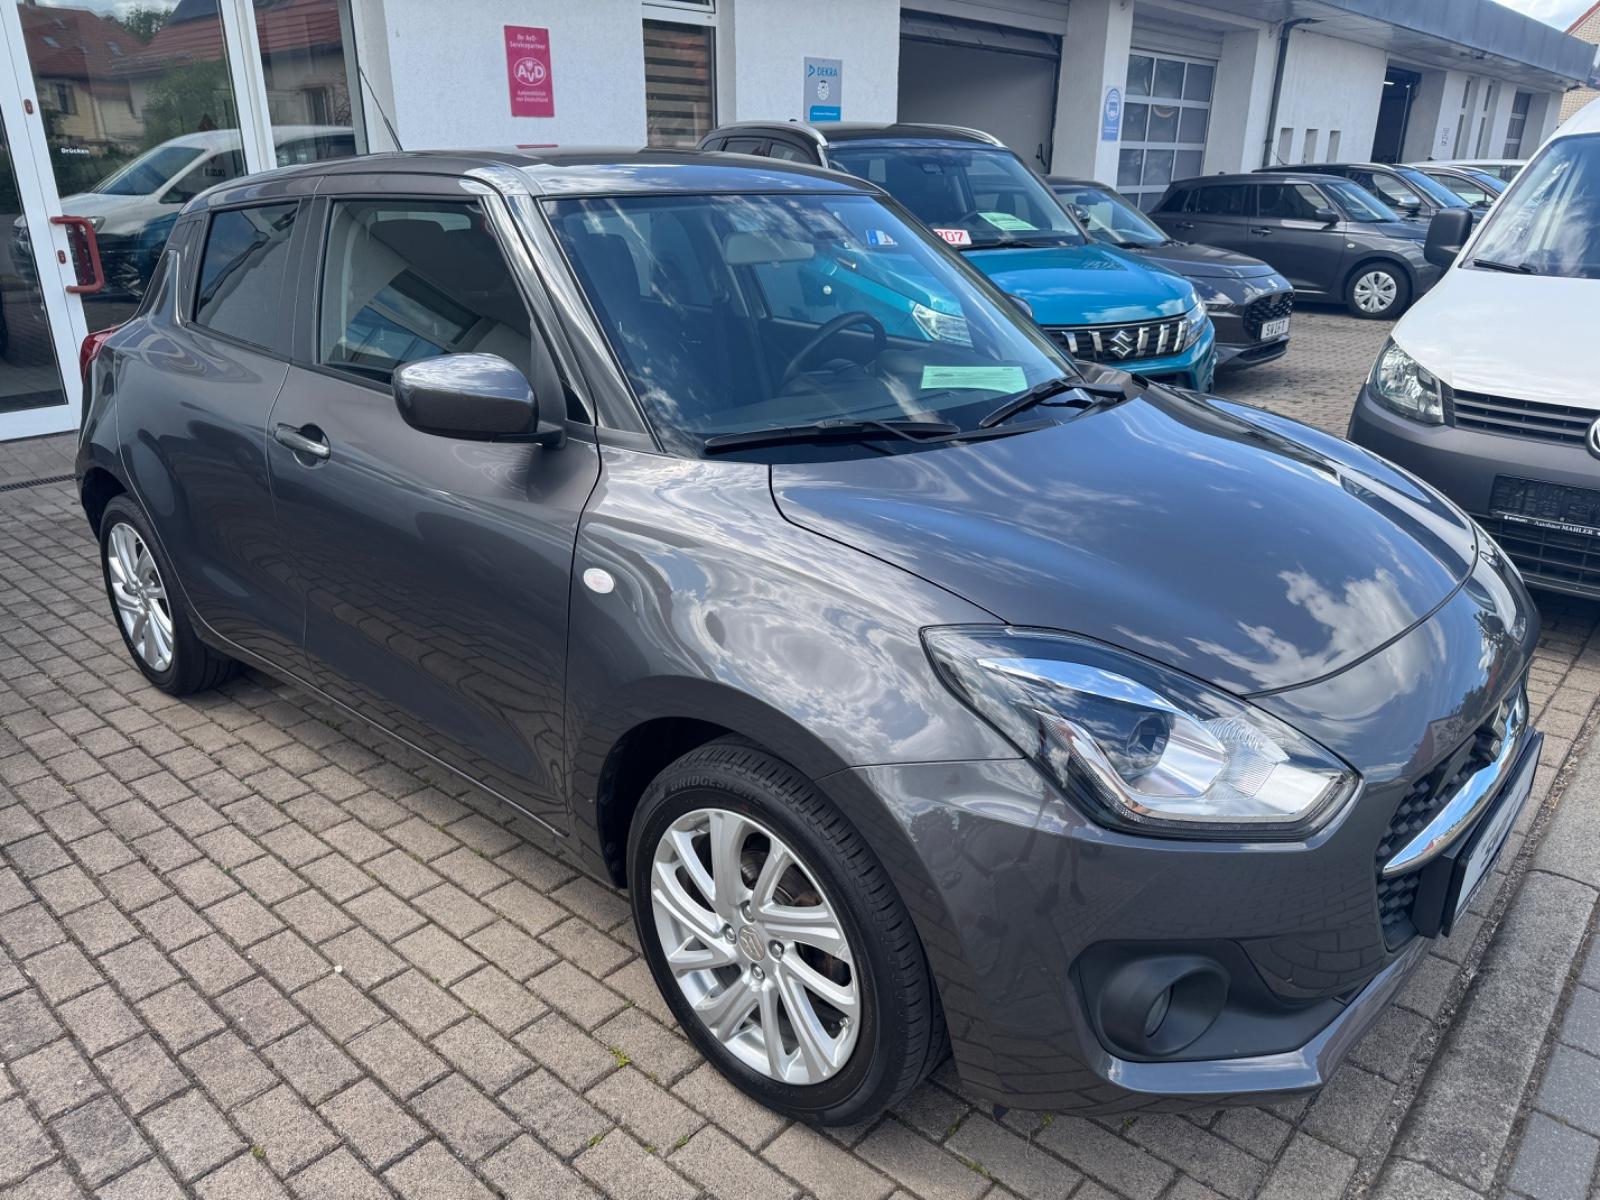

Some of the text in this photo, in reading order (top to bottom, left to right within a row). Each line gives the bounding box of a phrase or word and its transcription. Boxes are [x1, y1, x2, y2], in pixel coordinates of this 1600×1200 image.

[817, 66, 838, 78] DEKRA
[61, 147, 90, 155] Drücken
[1561, 525, 1593, 536] MAHLER
